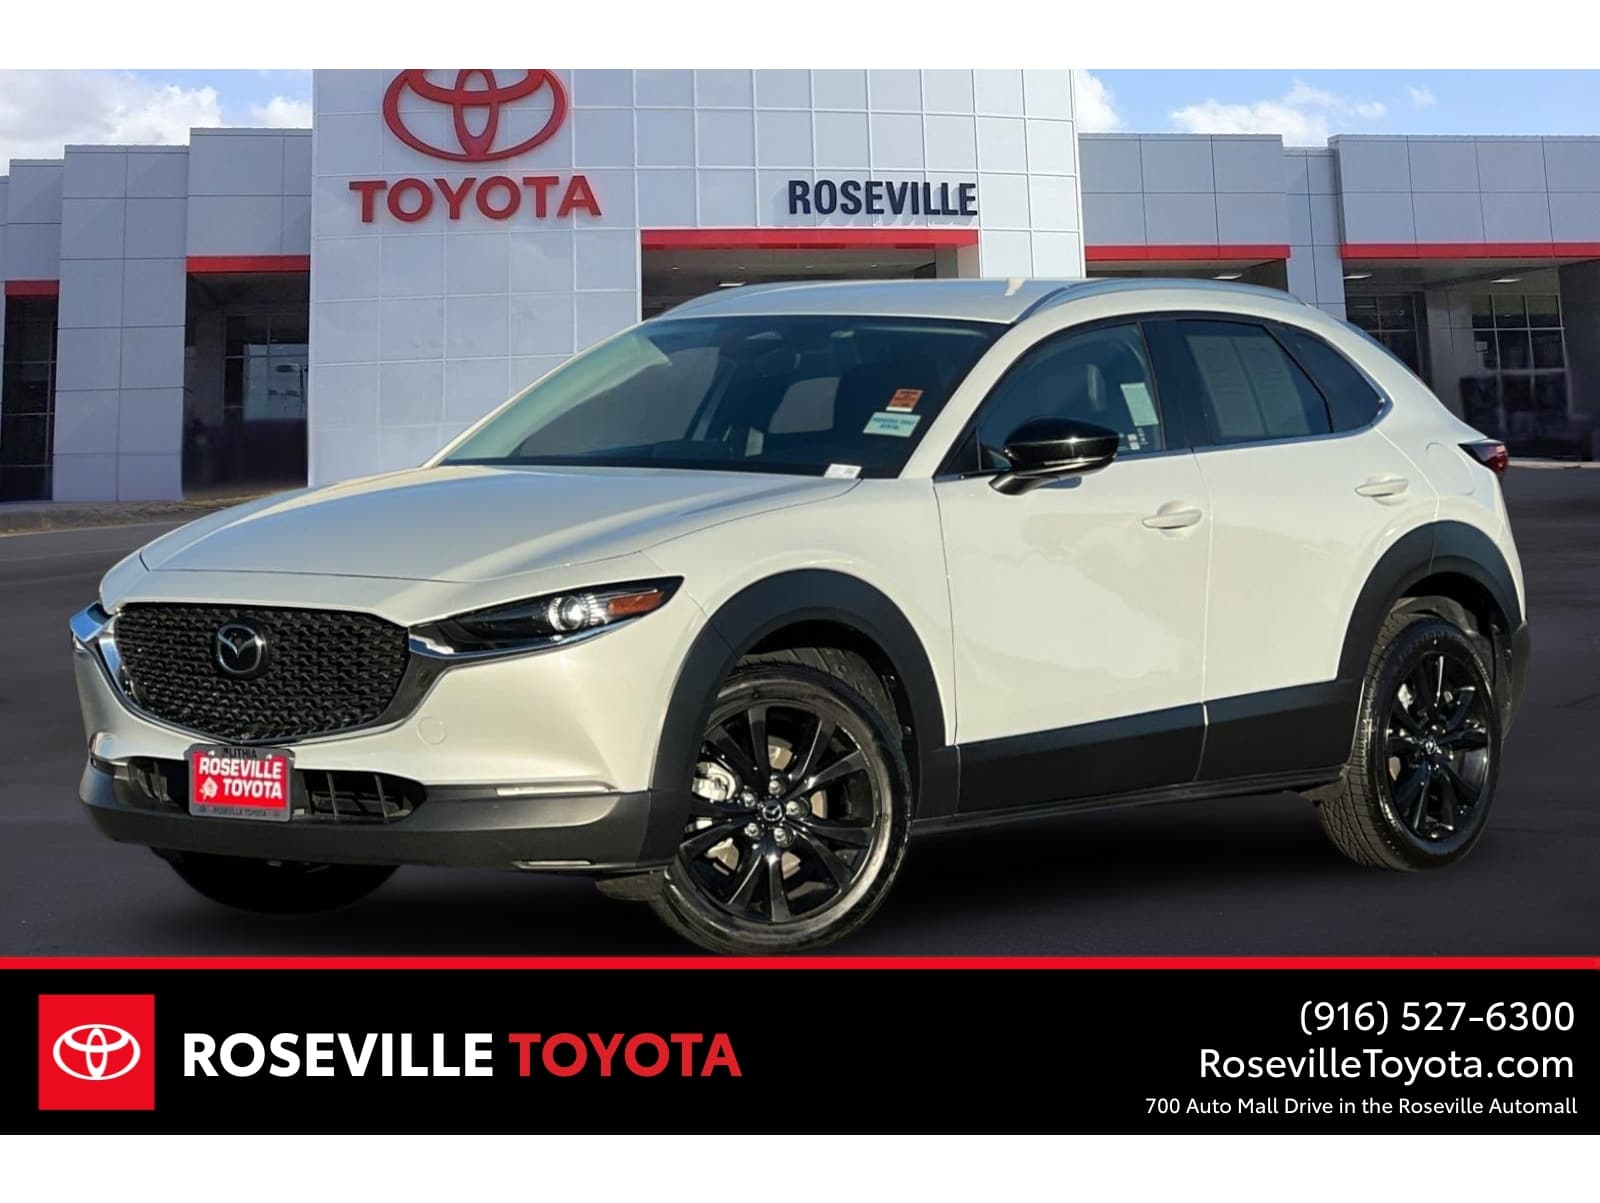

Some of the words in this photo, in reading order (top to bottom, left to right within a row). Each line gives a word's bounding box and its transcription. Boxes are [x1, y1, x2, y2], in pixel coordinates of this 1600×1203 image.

[349, 176, 602, 224] TOYOTA
[788, 180, 978, 216] ROSEVILLE
[199, 757, 283, 779] ROSEVILLE
[223, 778, 283, 800] TOYOTA
